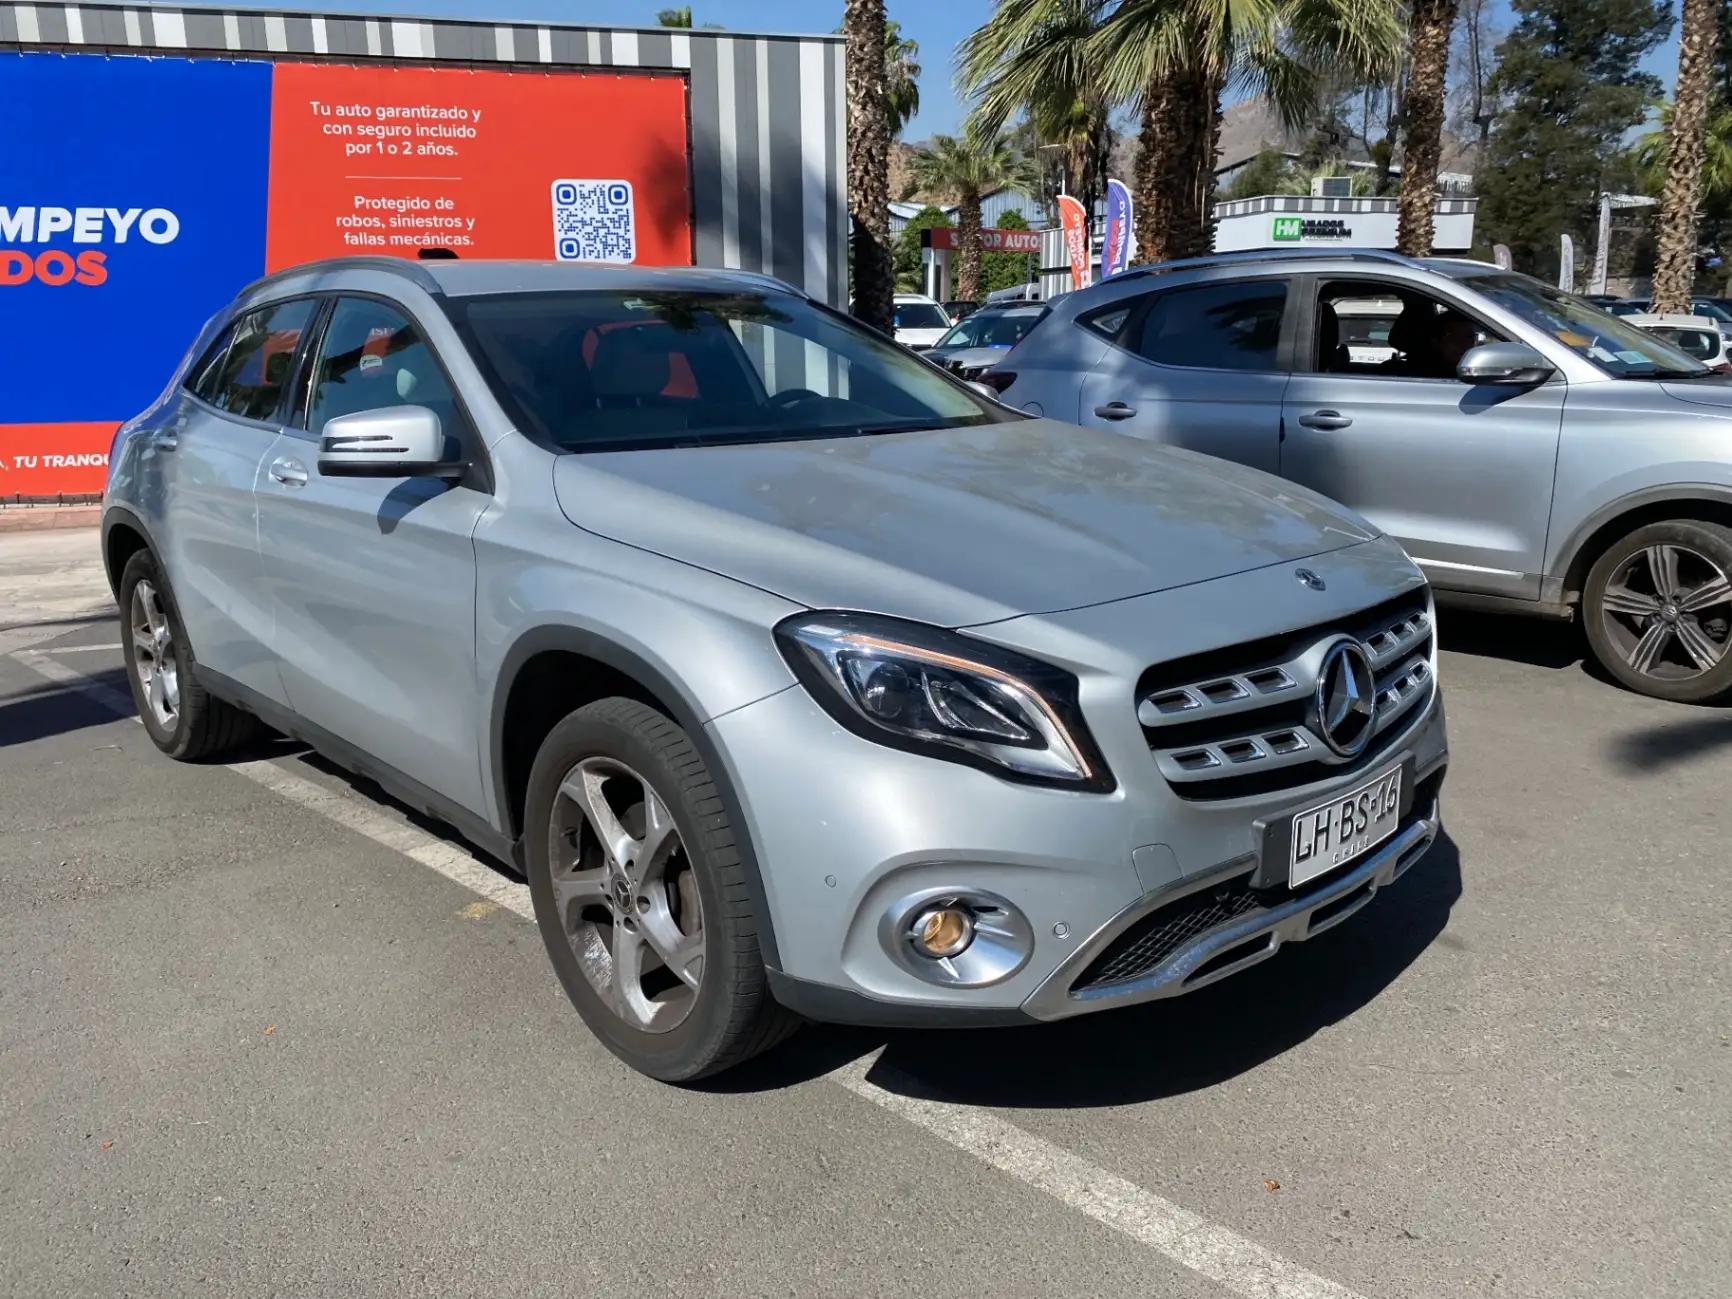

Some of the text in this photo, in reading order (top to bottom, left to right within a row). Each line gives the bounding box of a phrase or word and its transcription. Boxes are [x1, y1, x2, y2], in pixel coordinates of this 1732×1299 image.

[309, 101, 481, 122] Tu auto garantizado y
[322, 122, 477, 140] con seguro incluido
[345, 140, 459, 157] por 1 o 2 años.
[354, 195, 455, 213] Protegido de
[336, 214, 476, 231] robos, siniestros y
[1275, 219, 1300, 236] HM
[343, 231, 475, 246] fallas mecánicas.
[950, 232, 1002, 247] SOR
[13, 455, 38, 468] TU
